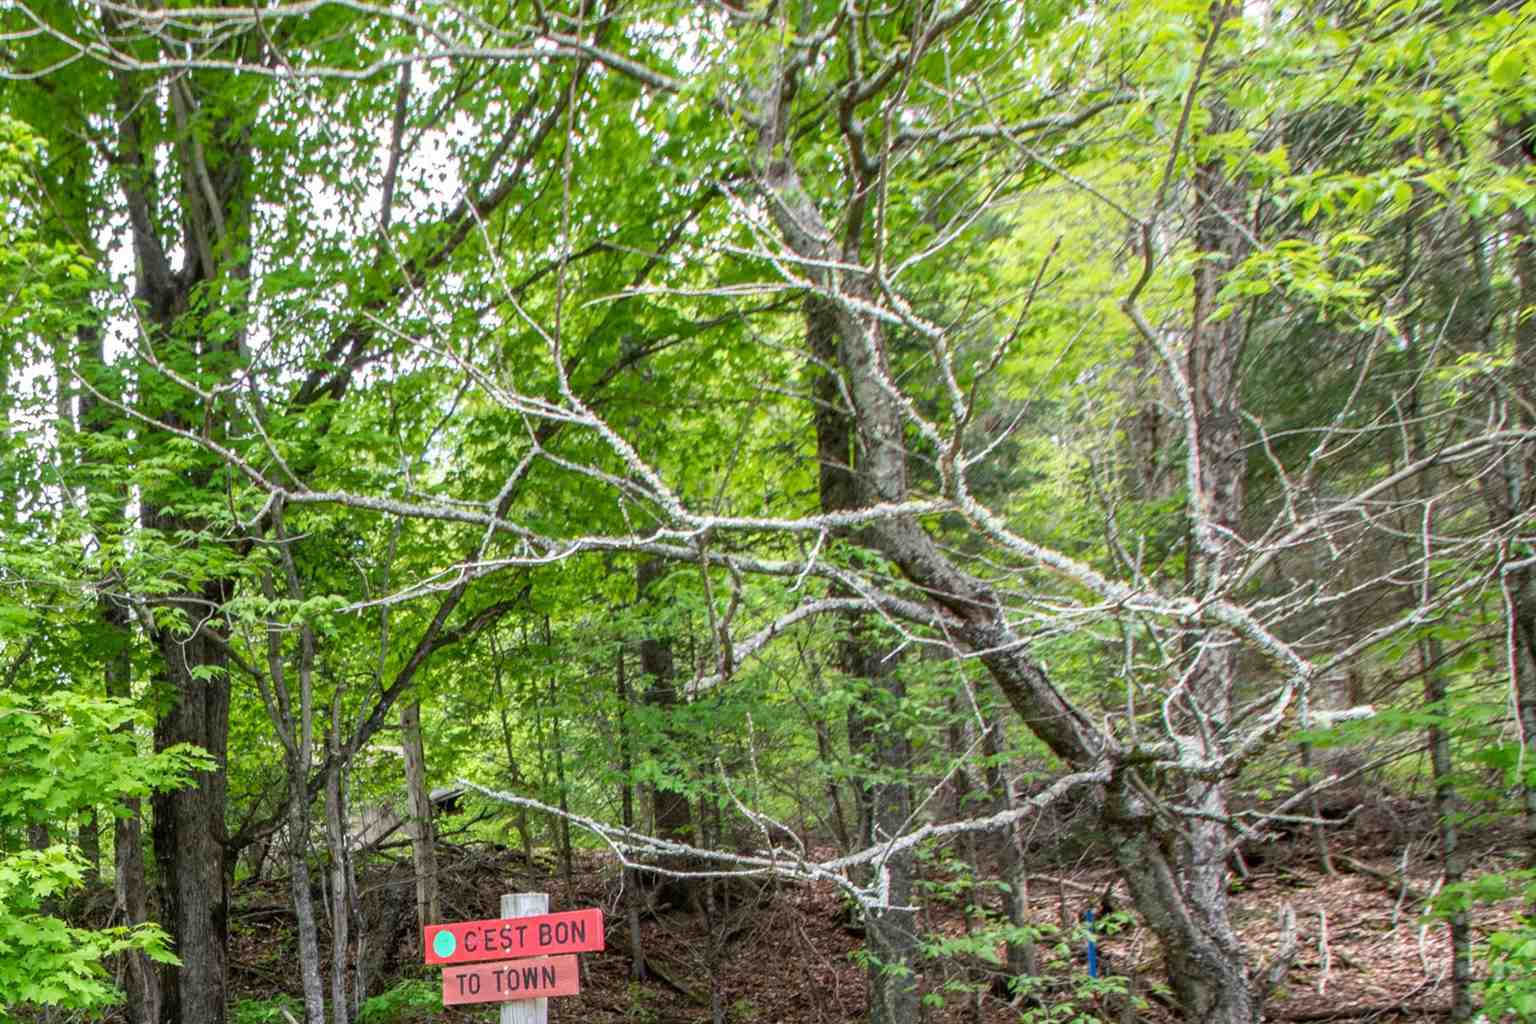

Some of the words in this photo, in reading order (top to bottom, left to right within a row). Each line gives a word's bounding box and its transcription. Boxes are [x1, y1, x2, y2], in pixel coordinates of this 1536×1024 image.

[464, 924, 528, 952] C'EST
[539, 919, 586, 946] BON
[456, 973, 480, 995] TO
[493, 965, 556, 993] TOWN
